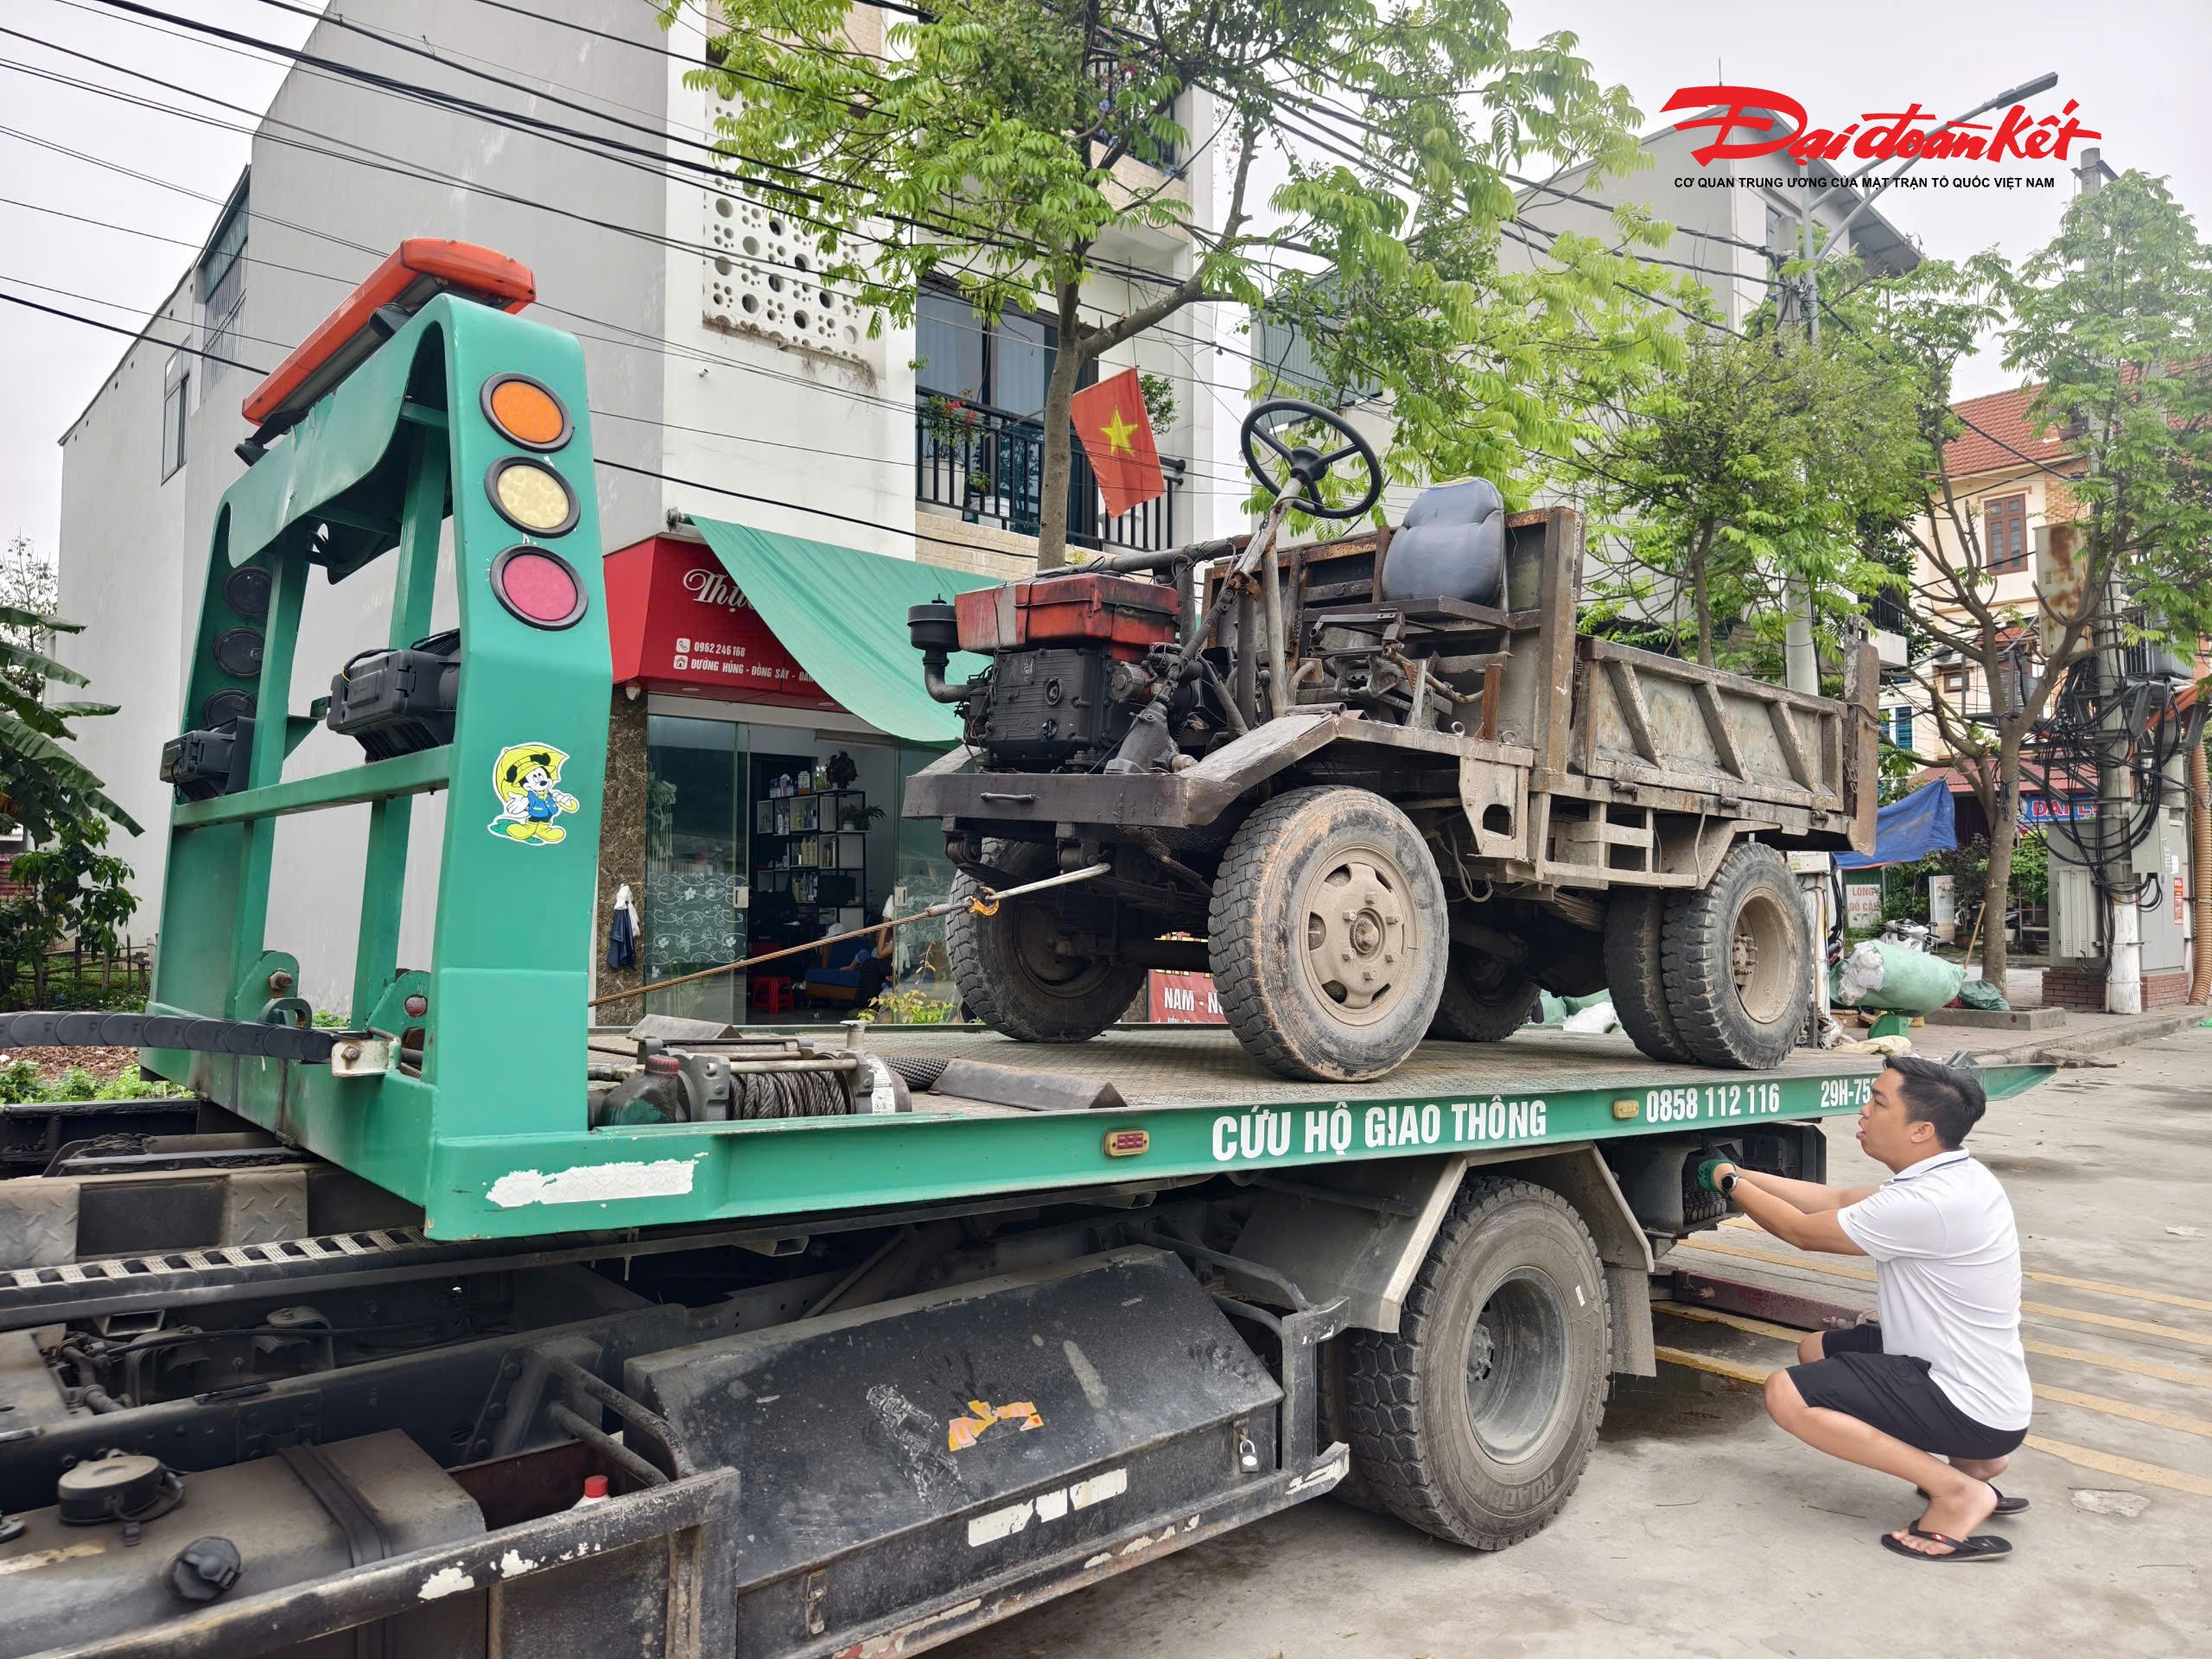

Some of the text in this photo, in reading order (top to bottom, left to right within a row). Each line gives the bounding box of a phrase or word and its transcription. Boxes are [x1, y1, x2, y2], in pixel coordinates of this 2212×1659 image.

[694, 641, 746, 658] 0962 246 168
[1852, 887, 1875, 897] LONG
[1164, 987, 1194, 1012] NAM
[1207, 991, 1224, 1015] N
[1646, 1083, 1780, 1123] 0858 112 116
[1212, 1095, 1547, 1162] CỨU HỘ GIAO THÔNG
